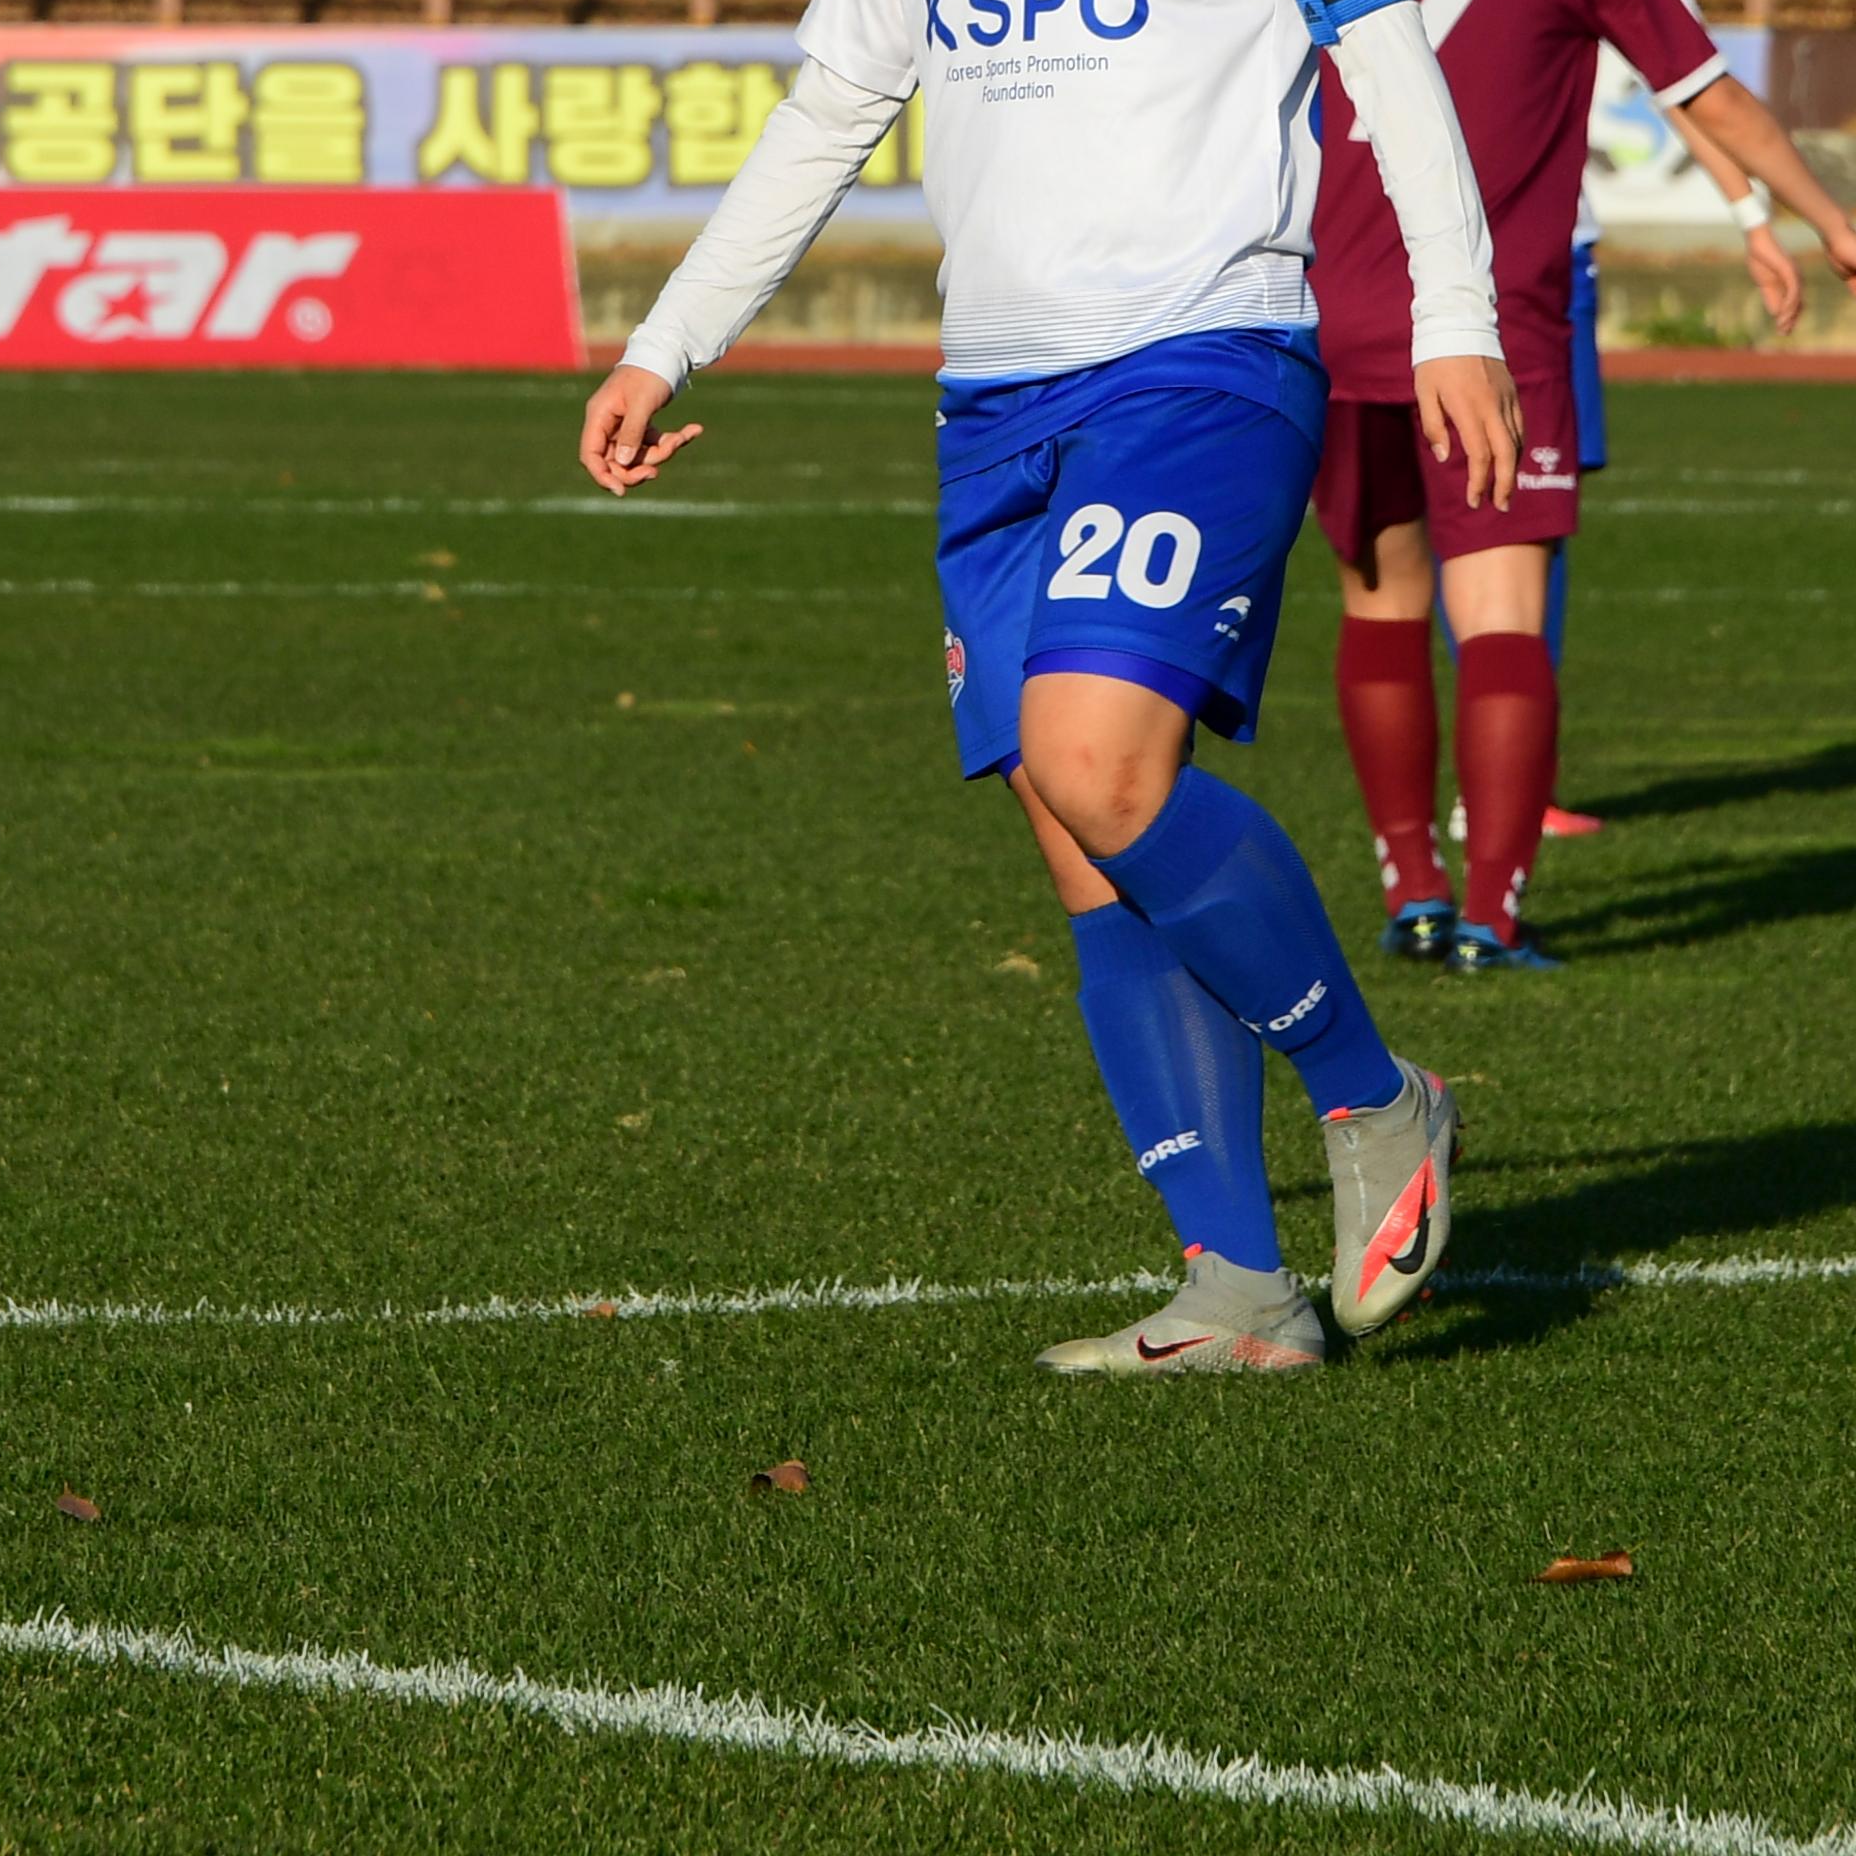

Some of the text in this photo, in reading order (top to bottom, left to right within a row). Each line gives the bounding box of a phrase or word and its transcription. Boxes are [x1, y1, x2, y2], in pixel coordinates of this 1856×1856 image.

[945, 52, 1110, 84] Korea Sports Promotion
[982, 81, 1055, 104] Foundation
[1046, 502, 1202, 610] 20
